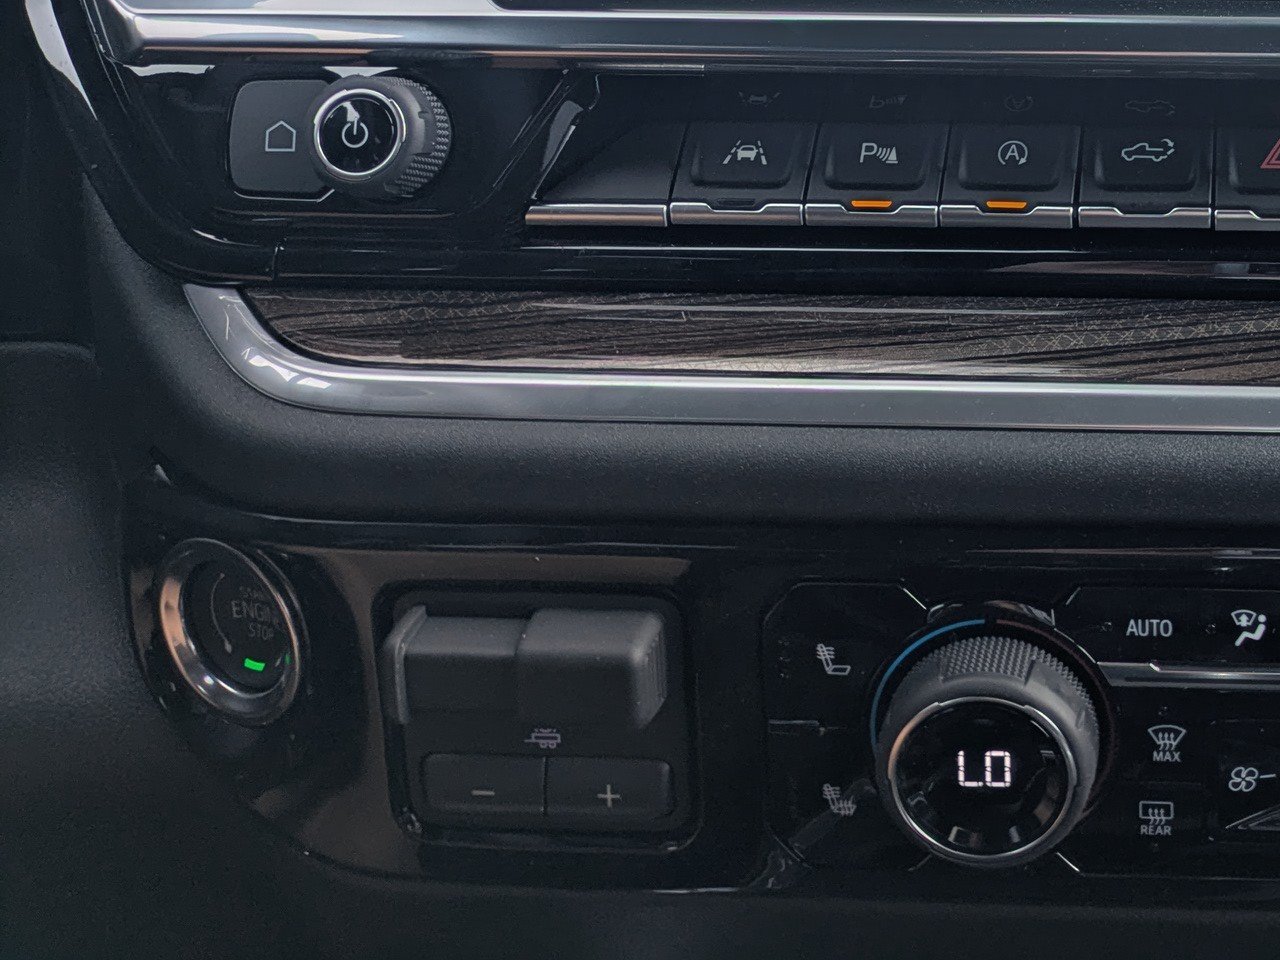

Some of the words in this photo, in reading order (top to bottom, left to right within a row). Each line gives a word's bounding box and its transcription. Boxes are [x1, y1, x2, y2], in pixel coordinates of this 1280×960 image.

[1127, 620, 1173, 637] AUTO
[1153, 750, 1181, 762] MAX
[958, 750, 1011, 788] LO
[1141, 825, 1172, 836] REAR
